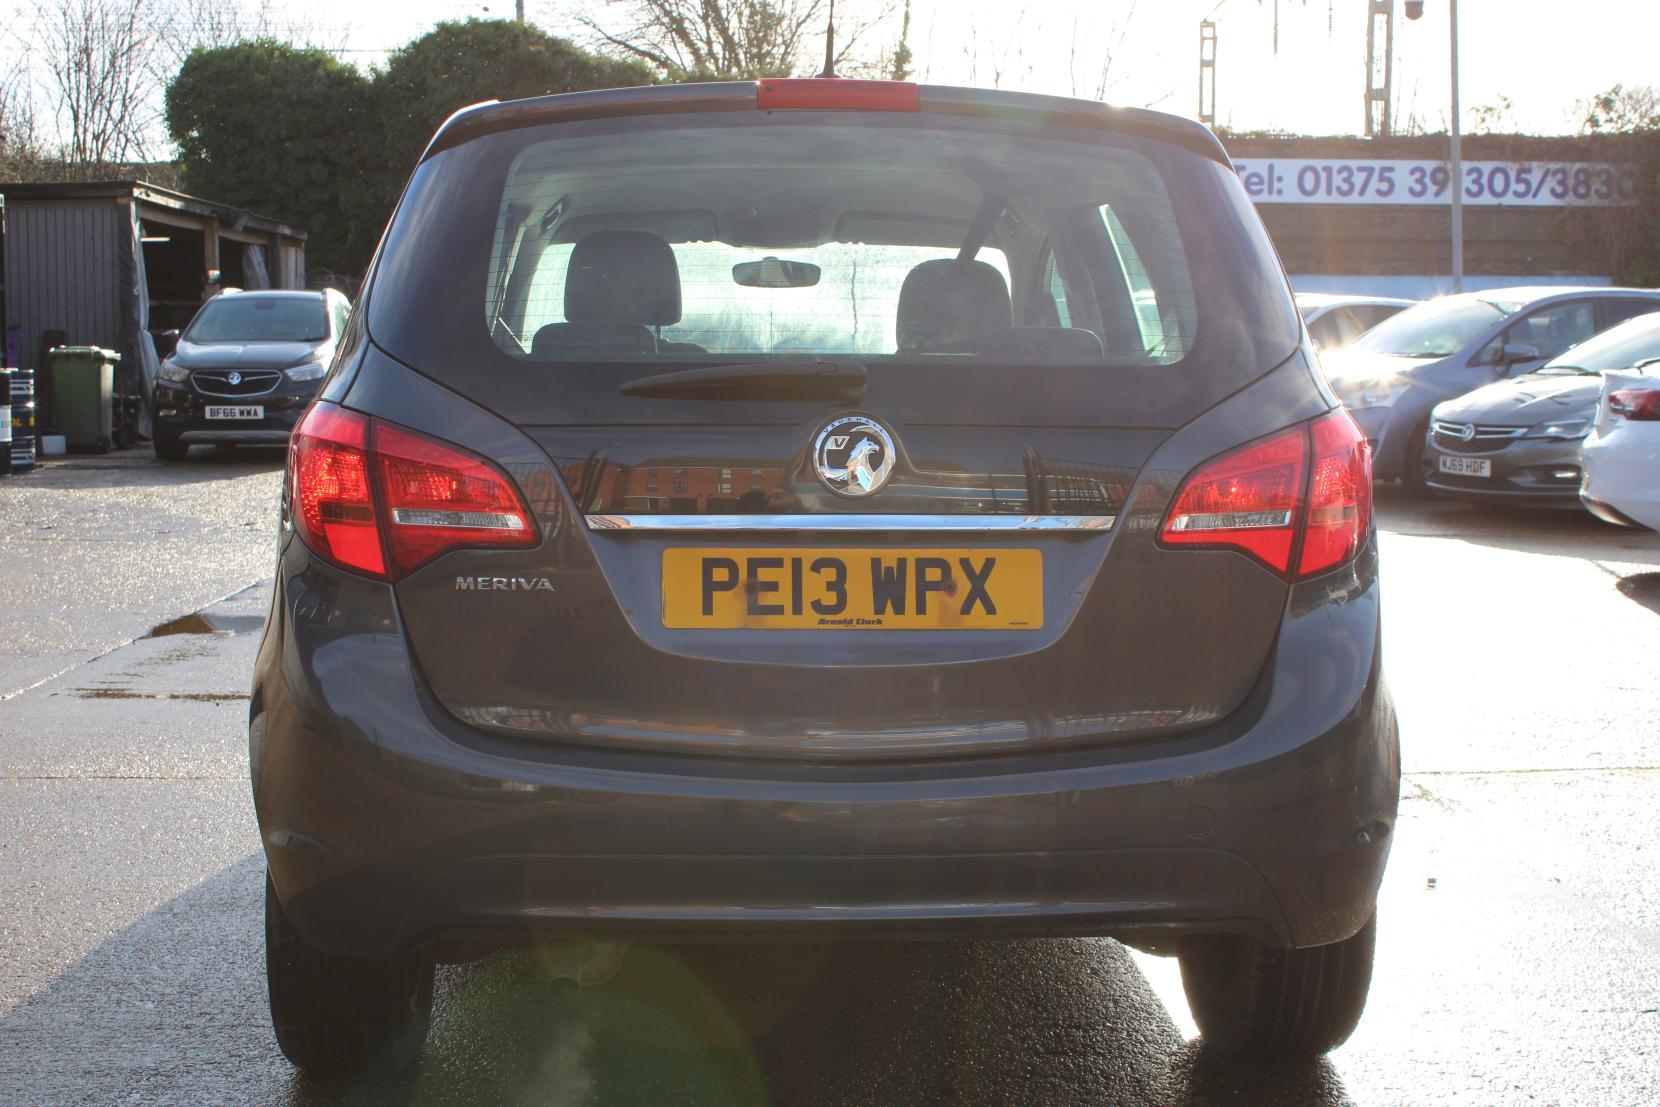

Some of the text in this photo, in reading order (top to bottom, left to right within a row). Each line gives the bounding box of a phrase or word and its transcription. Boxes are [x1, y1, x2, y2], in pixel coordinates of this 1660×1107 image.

[1297, 165, 1395, 198] 01375
[209, 407, 236, 417] BF66
[1465, 460, 1486, 474] HDF
[455, 576, 556, 591] MERIVA
[701, 557, 997, 616] PE13 WPX
